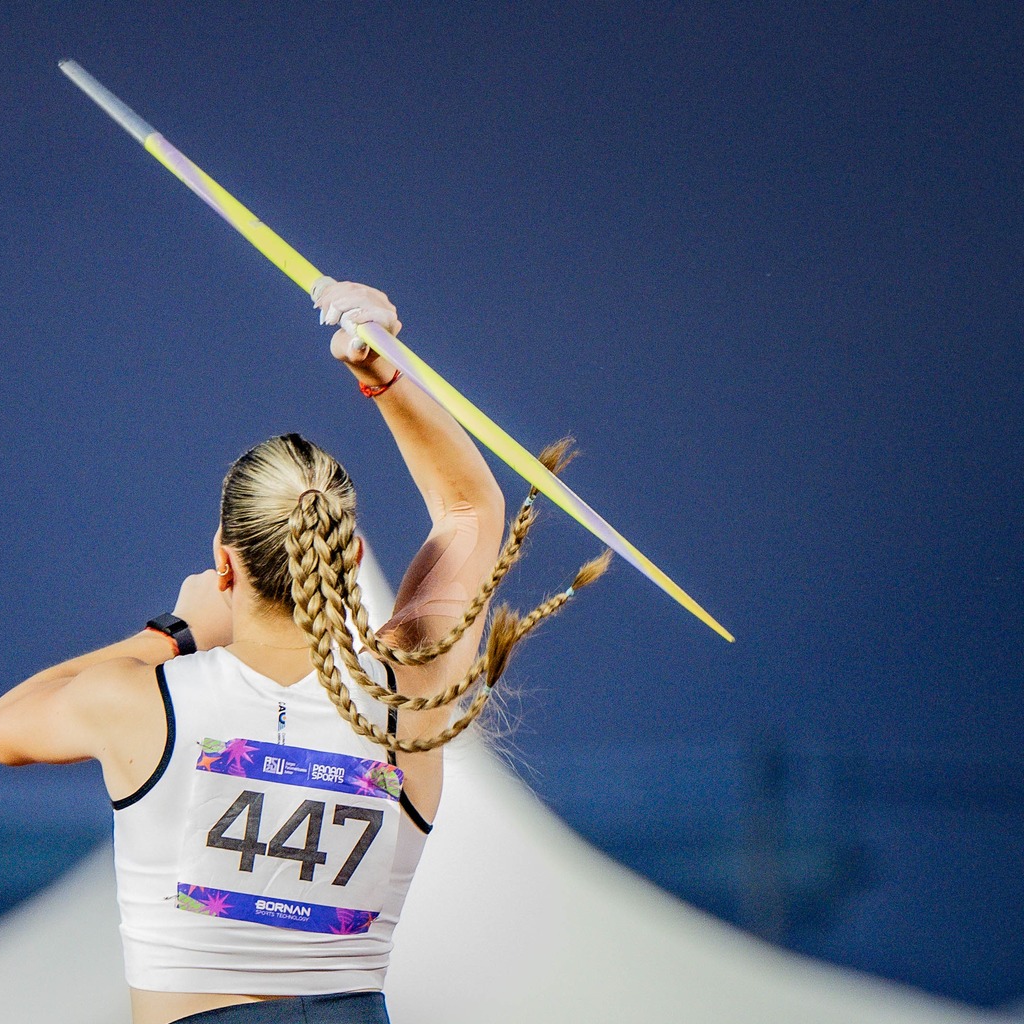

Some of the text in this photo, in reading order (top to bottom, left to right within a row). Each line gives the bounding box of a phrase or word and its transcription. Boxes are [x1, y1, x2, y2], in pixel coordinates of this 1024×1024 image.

[312, 764, 345, 776] PANAM
[311, 772, 344, 784] SPORTS
[206, 790, 384, 887] 447
[255, 899, 311, 917] BORNAN
[255, 909, 310, 922] SPORTS TECHNOLOGY
